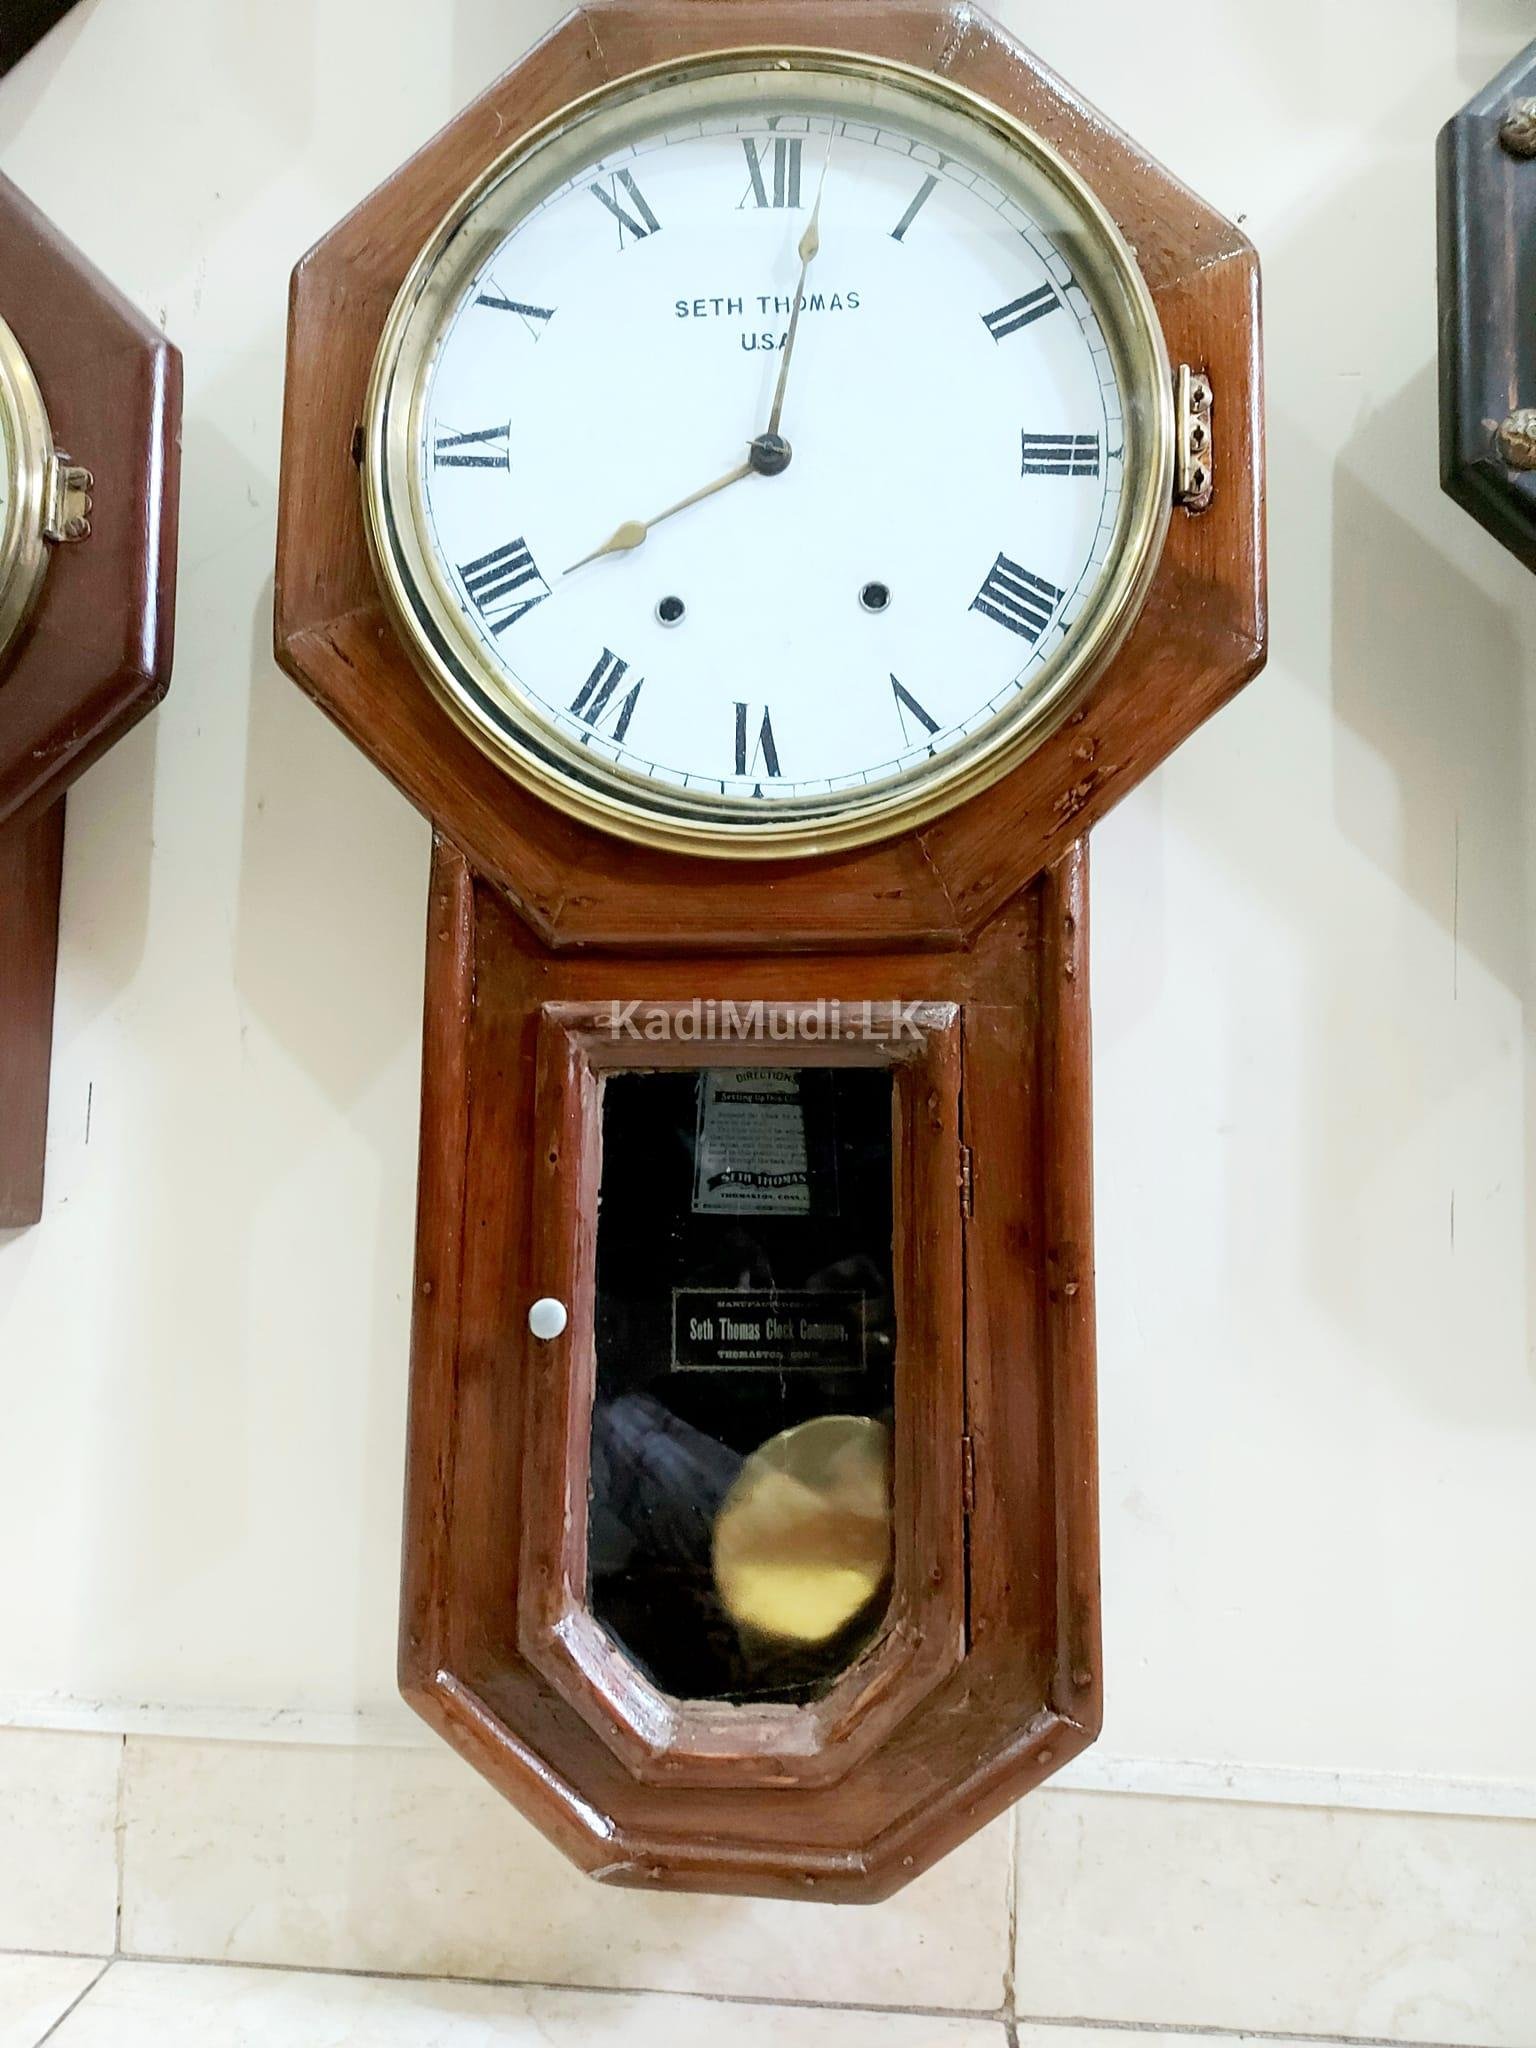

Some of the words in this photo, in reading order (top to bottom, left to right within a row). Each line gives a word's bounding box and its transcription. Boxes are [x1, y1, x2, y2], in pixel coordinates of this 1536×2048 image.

[588, 167, 661, 250] XI
[737, 137, 804, 209] XII
[472, 274, 556, 342] X
[675, 297, 743, 318] SETH
[756, 291, 861, 315] THOMAS
[979, 279, 1064, 345] II
[1021, 429, 1099, 478] III
[455, 537, 553, 641] VIII
[967, 552, 1068, 645] IIII
[566, 647, 645, 745] VII
[889, 672, 944, 749] V
[732, 702, 781, 778] VI
[720, 1172, 752, 1183] SETH
[756, 1172, 808, 1186] THOMAS
[689, 1317, 714, 1341] Seth
[719, 1317, 761, 1341] Thomas
[765, 1317, 795, 1341] Clock
